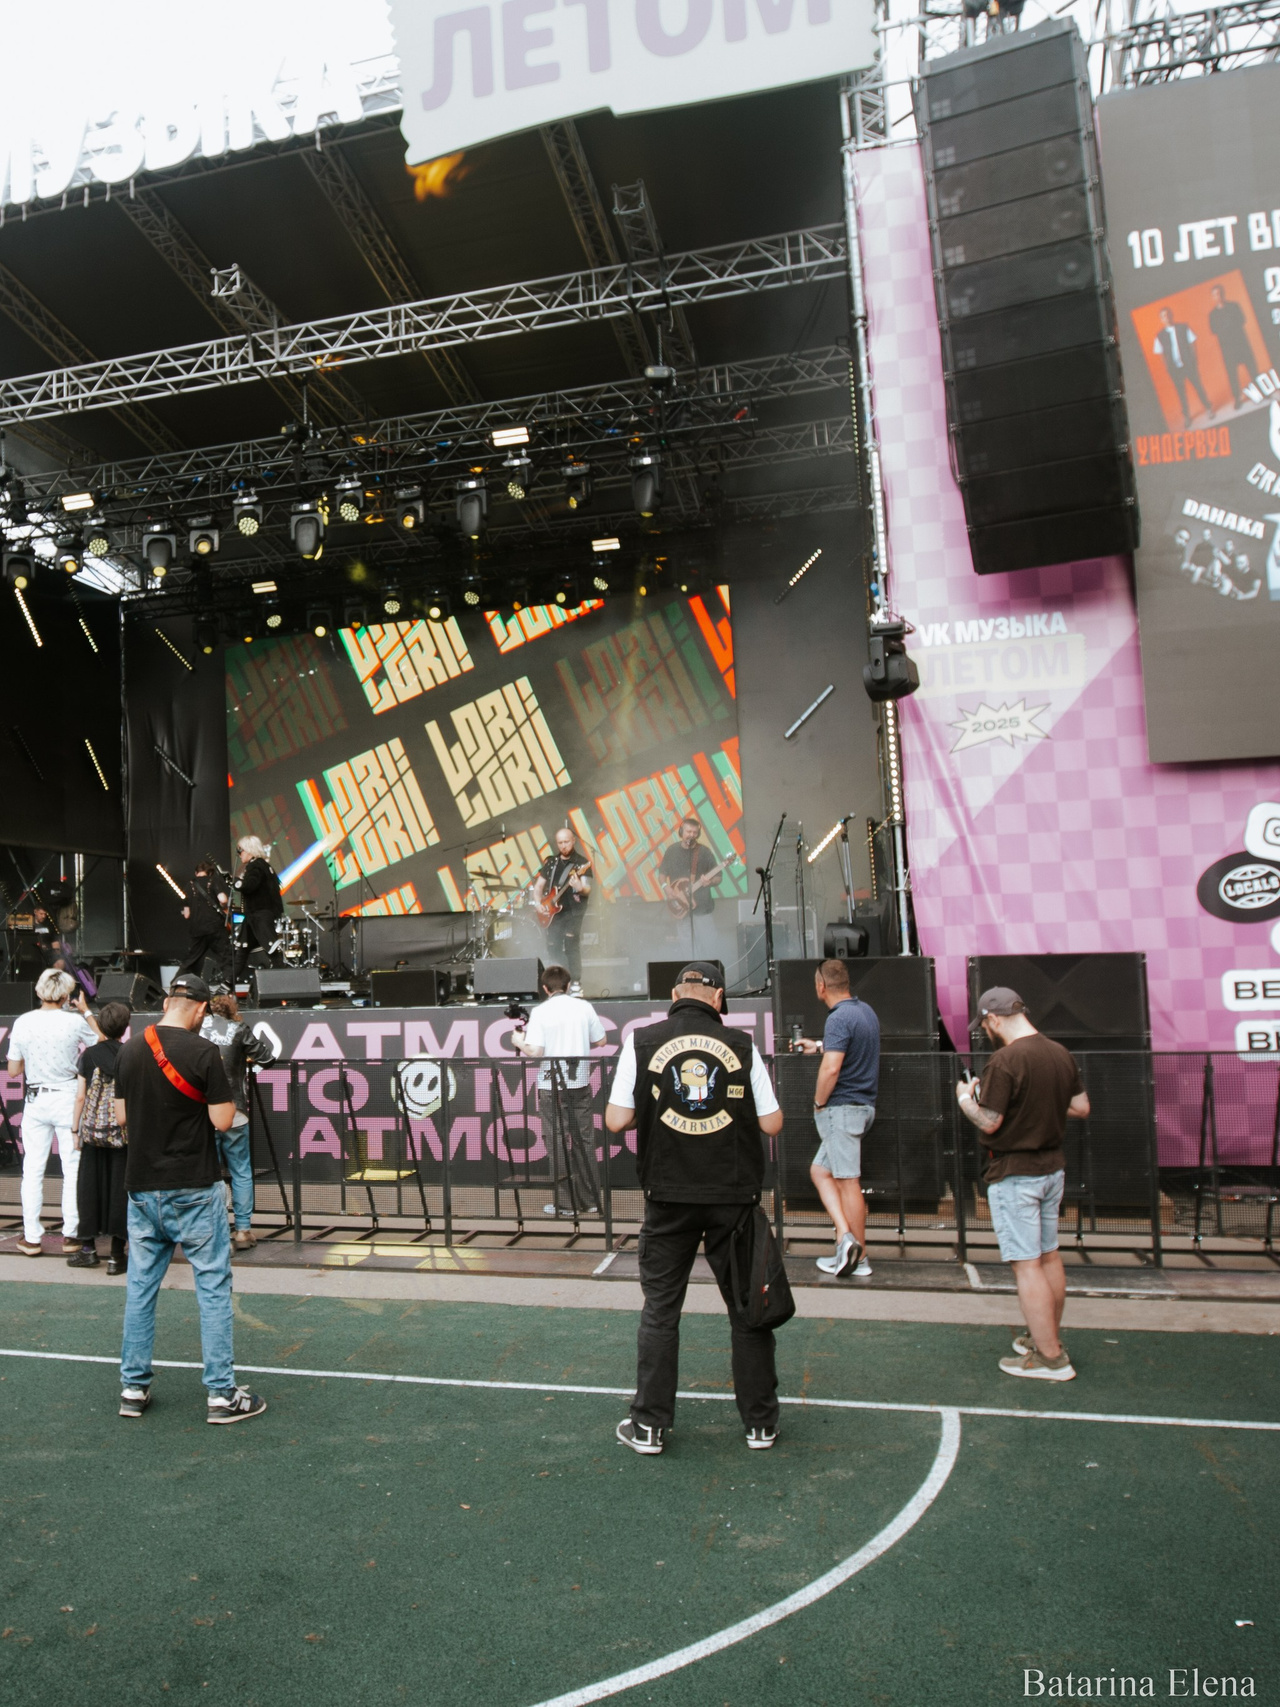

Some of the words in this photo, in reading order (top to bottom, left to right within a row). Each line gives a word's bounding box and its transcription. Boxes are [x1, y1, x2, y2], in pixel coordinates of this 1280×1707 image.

[1127, 228, 1164, 269] 10
[1174, 216, 1238, 262] ЛЕТ
[1137, 426, 1232, 466] УНДЕРВУД
[919, 622, 951, 647] VK
[955, 611, 1068, 644] МУЗЫКА
[924, 641, 1070, 688] ЛЕТОМ
[971, 716, 1021, 733] 2025
[1224, 875, 1280, 898] LOCALS
[655, 1039, 686, 1064] NIGHT
[690, 1037, 735, 1065] MINIONS
[729, 1087, 743, 1096] MGG
[669, 1114, 725, 1132] NARNIA
